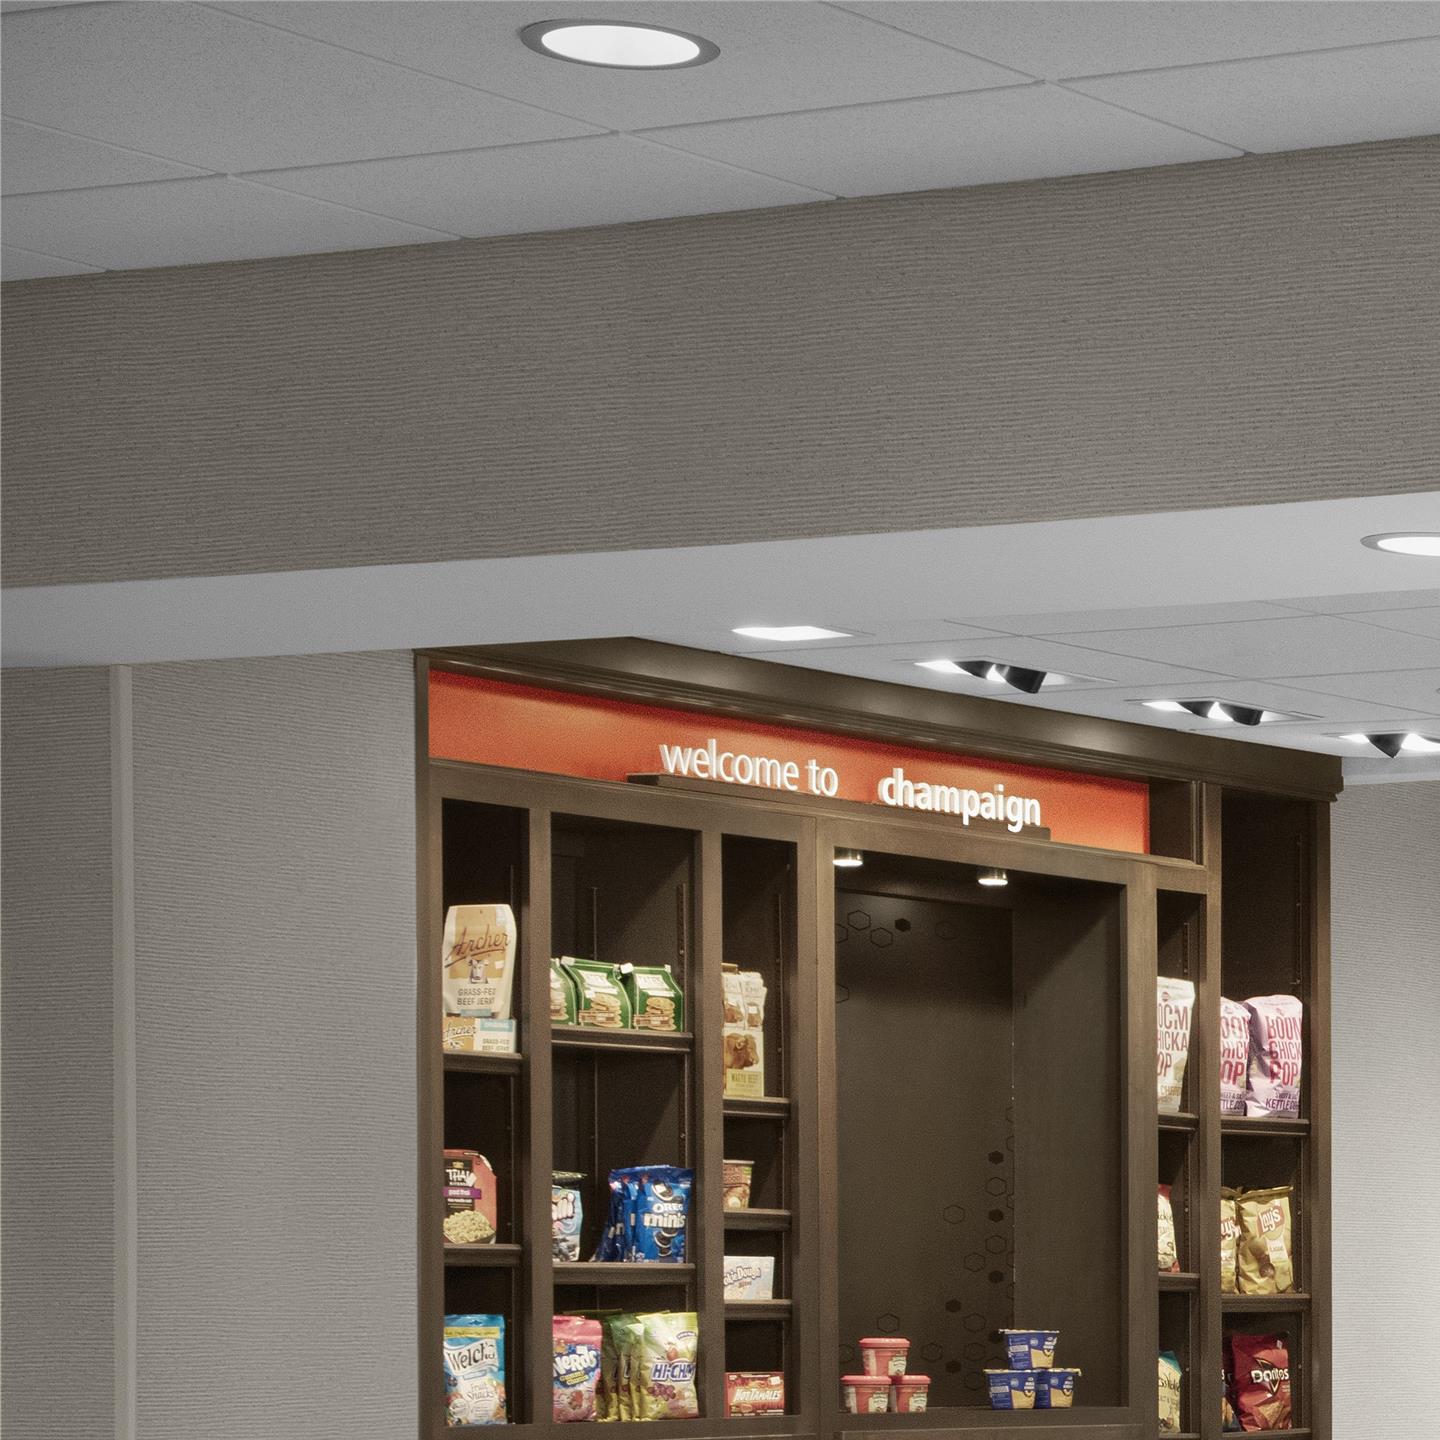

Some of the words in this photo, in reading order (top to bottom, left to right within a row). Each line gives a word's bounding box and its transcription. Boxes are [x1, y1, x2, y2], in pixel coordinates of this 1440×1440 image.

[659, 738, 800, 791] welcome
[806, 759, 839, 797] to
[877, 767, 1041, 833] champaign
[445, 924, 510, 961] Archer
[456, 997, 475, 1006] BEEF
[1157, 1030, 1188, 1051] HICKA
[1157, 1052, 1172, 1077] OP
[1220, 1061, 1245, 1085] OP
[644, 1212, 686, 1228] minis
[1259, 1207, 1281, 1234] Lay's
[1251, 1368, 1290, 1383] Doritos
